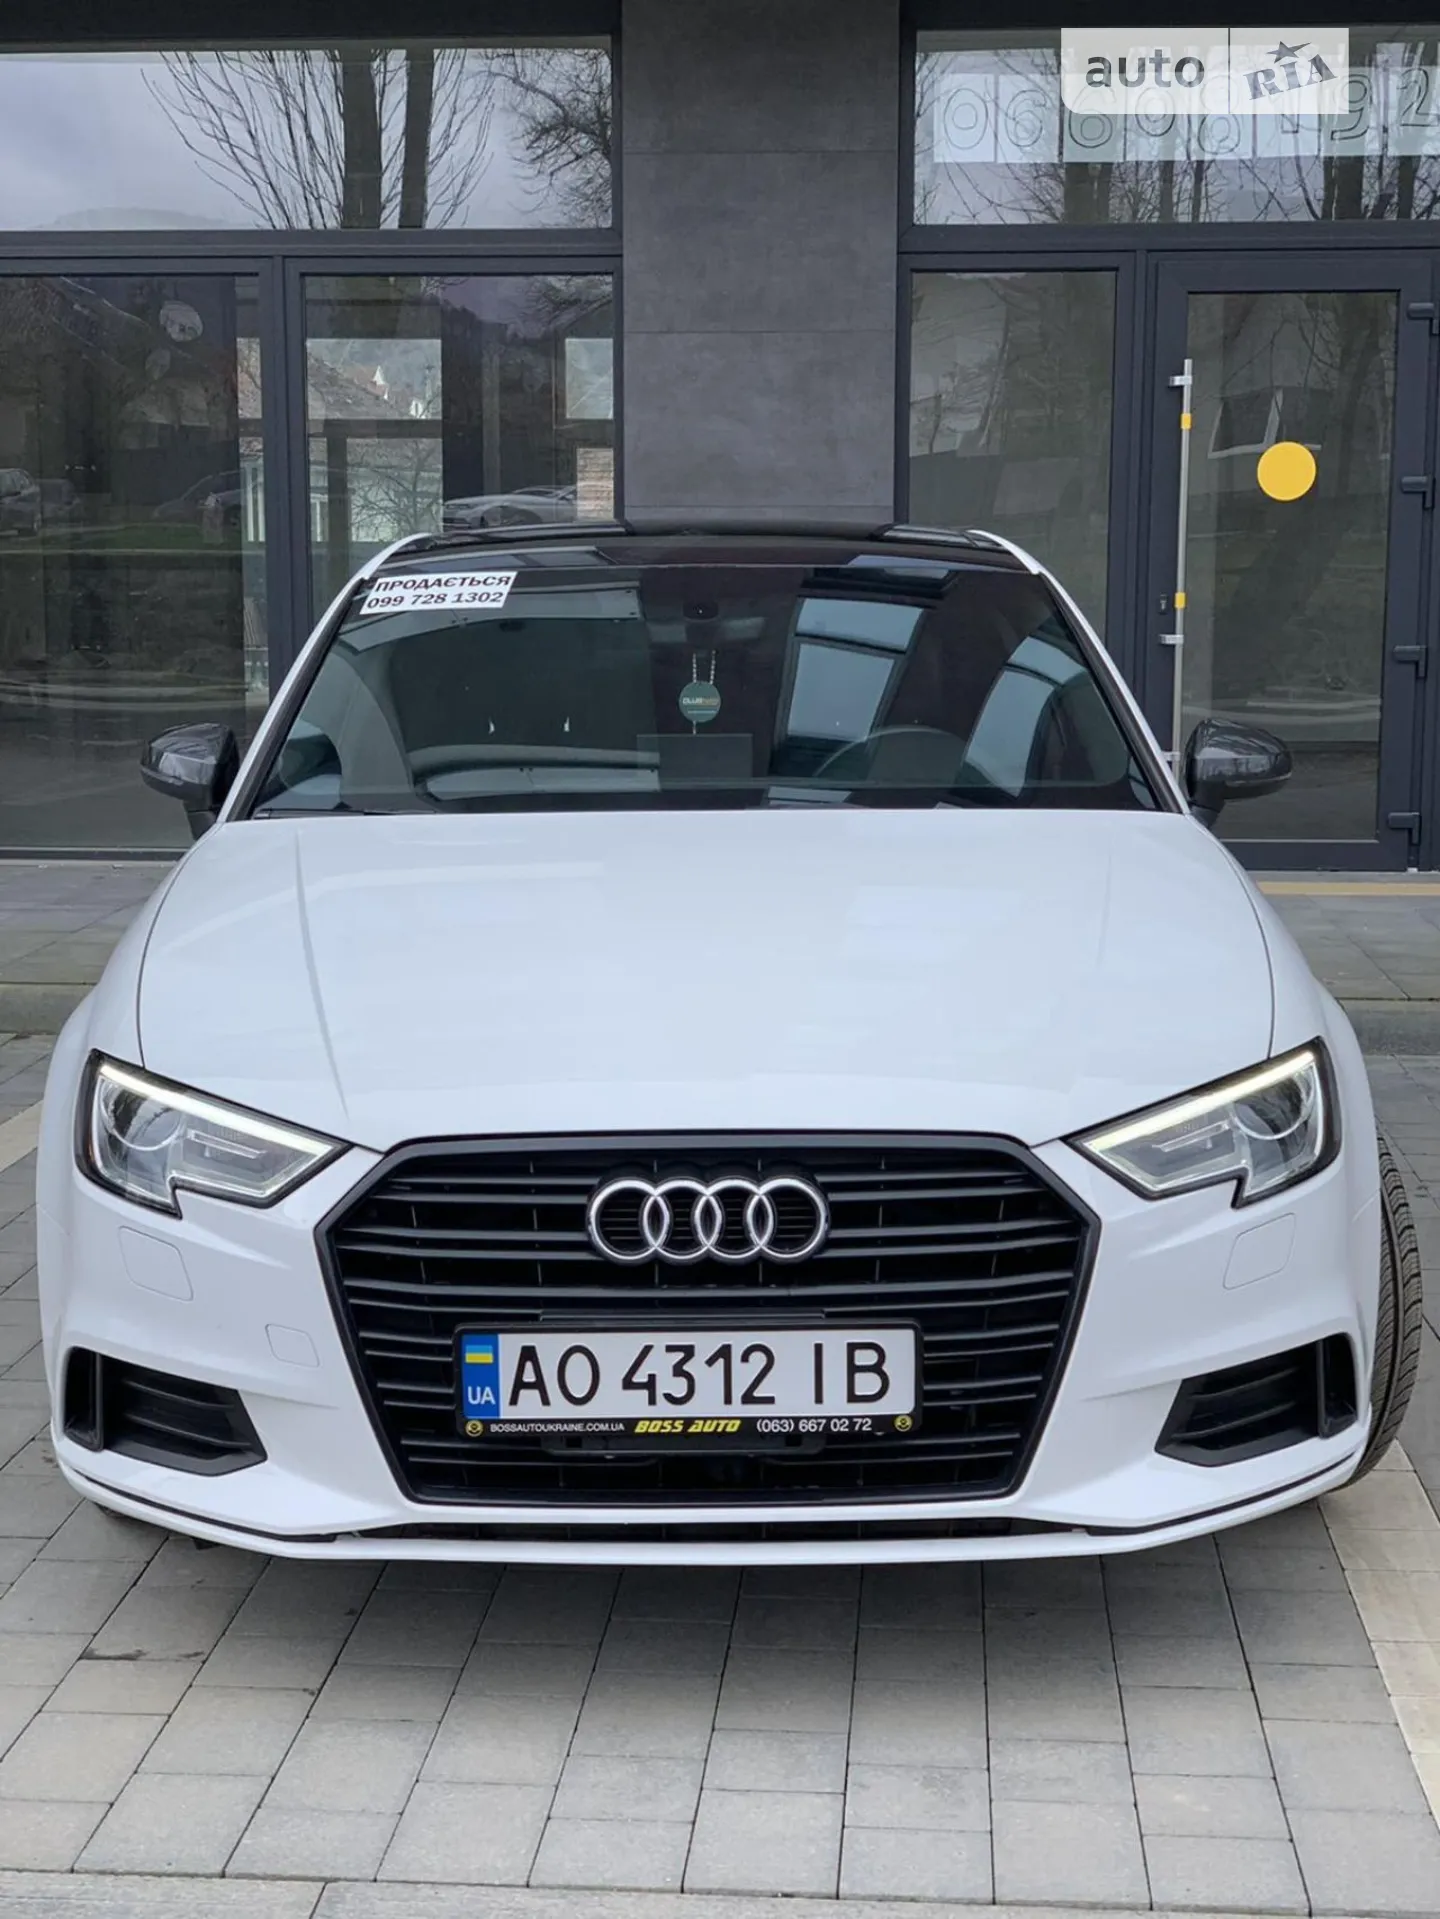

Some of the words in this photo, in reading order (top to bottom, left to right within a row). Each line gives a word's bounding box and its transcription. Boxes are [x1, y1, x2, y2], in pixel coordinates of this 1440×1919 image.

[374, 576, 512, 592] ПРОДАЄТЬСЯ
[366, 595, 405, 609] 099
[411, 593, 448, 606] 728
[450, 591, 504, 604] 1302
[508, 1344, 601, 1407] AO
[621, 1343, 776, 1407] 4312
[813, 1341, 891, 1406] IB
[467, 1386, 495, 1405] UA
[489, 1422, 625, 1434] BOSSAUTOUKRAINE.COM.UA
[634, 1420, 685, 1433] BOSS
[688, 1419, 742, 1433] AUTO
[756, 1418, 795, 1432] (063)
[799, 1419, 826, 1432] 667
[830, 1418, 849, 1431] 02
[853, 1417, 872, 1431] 72
